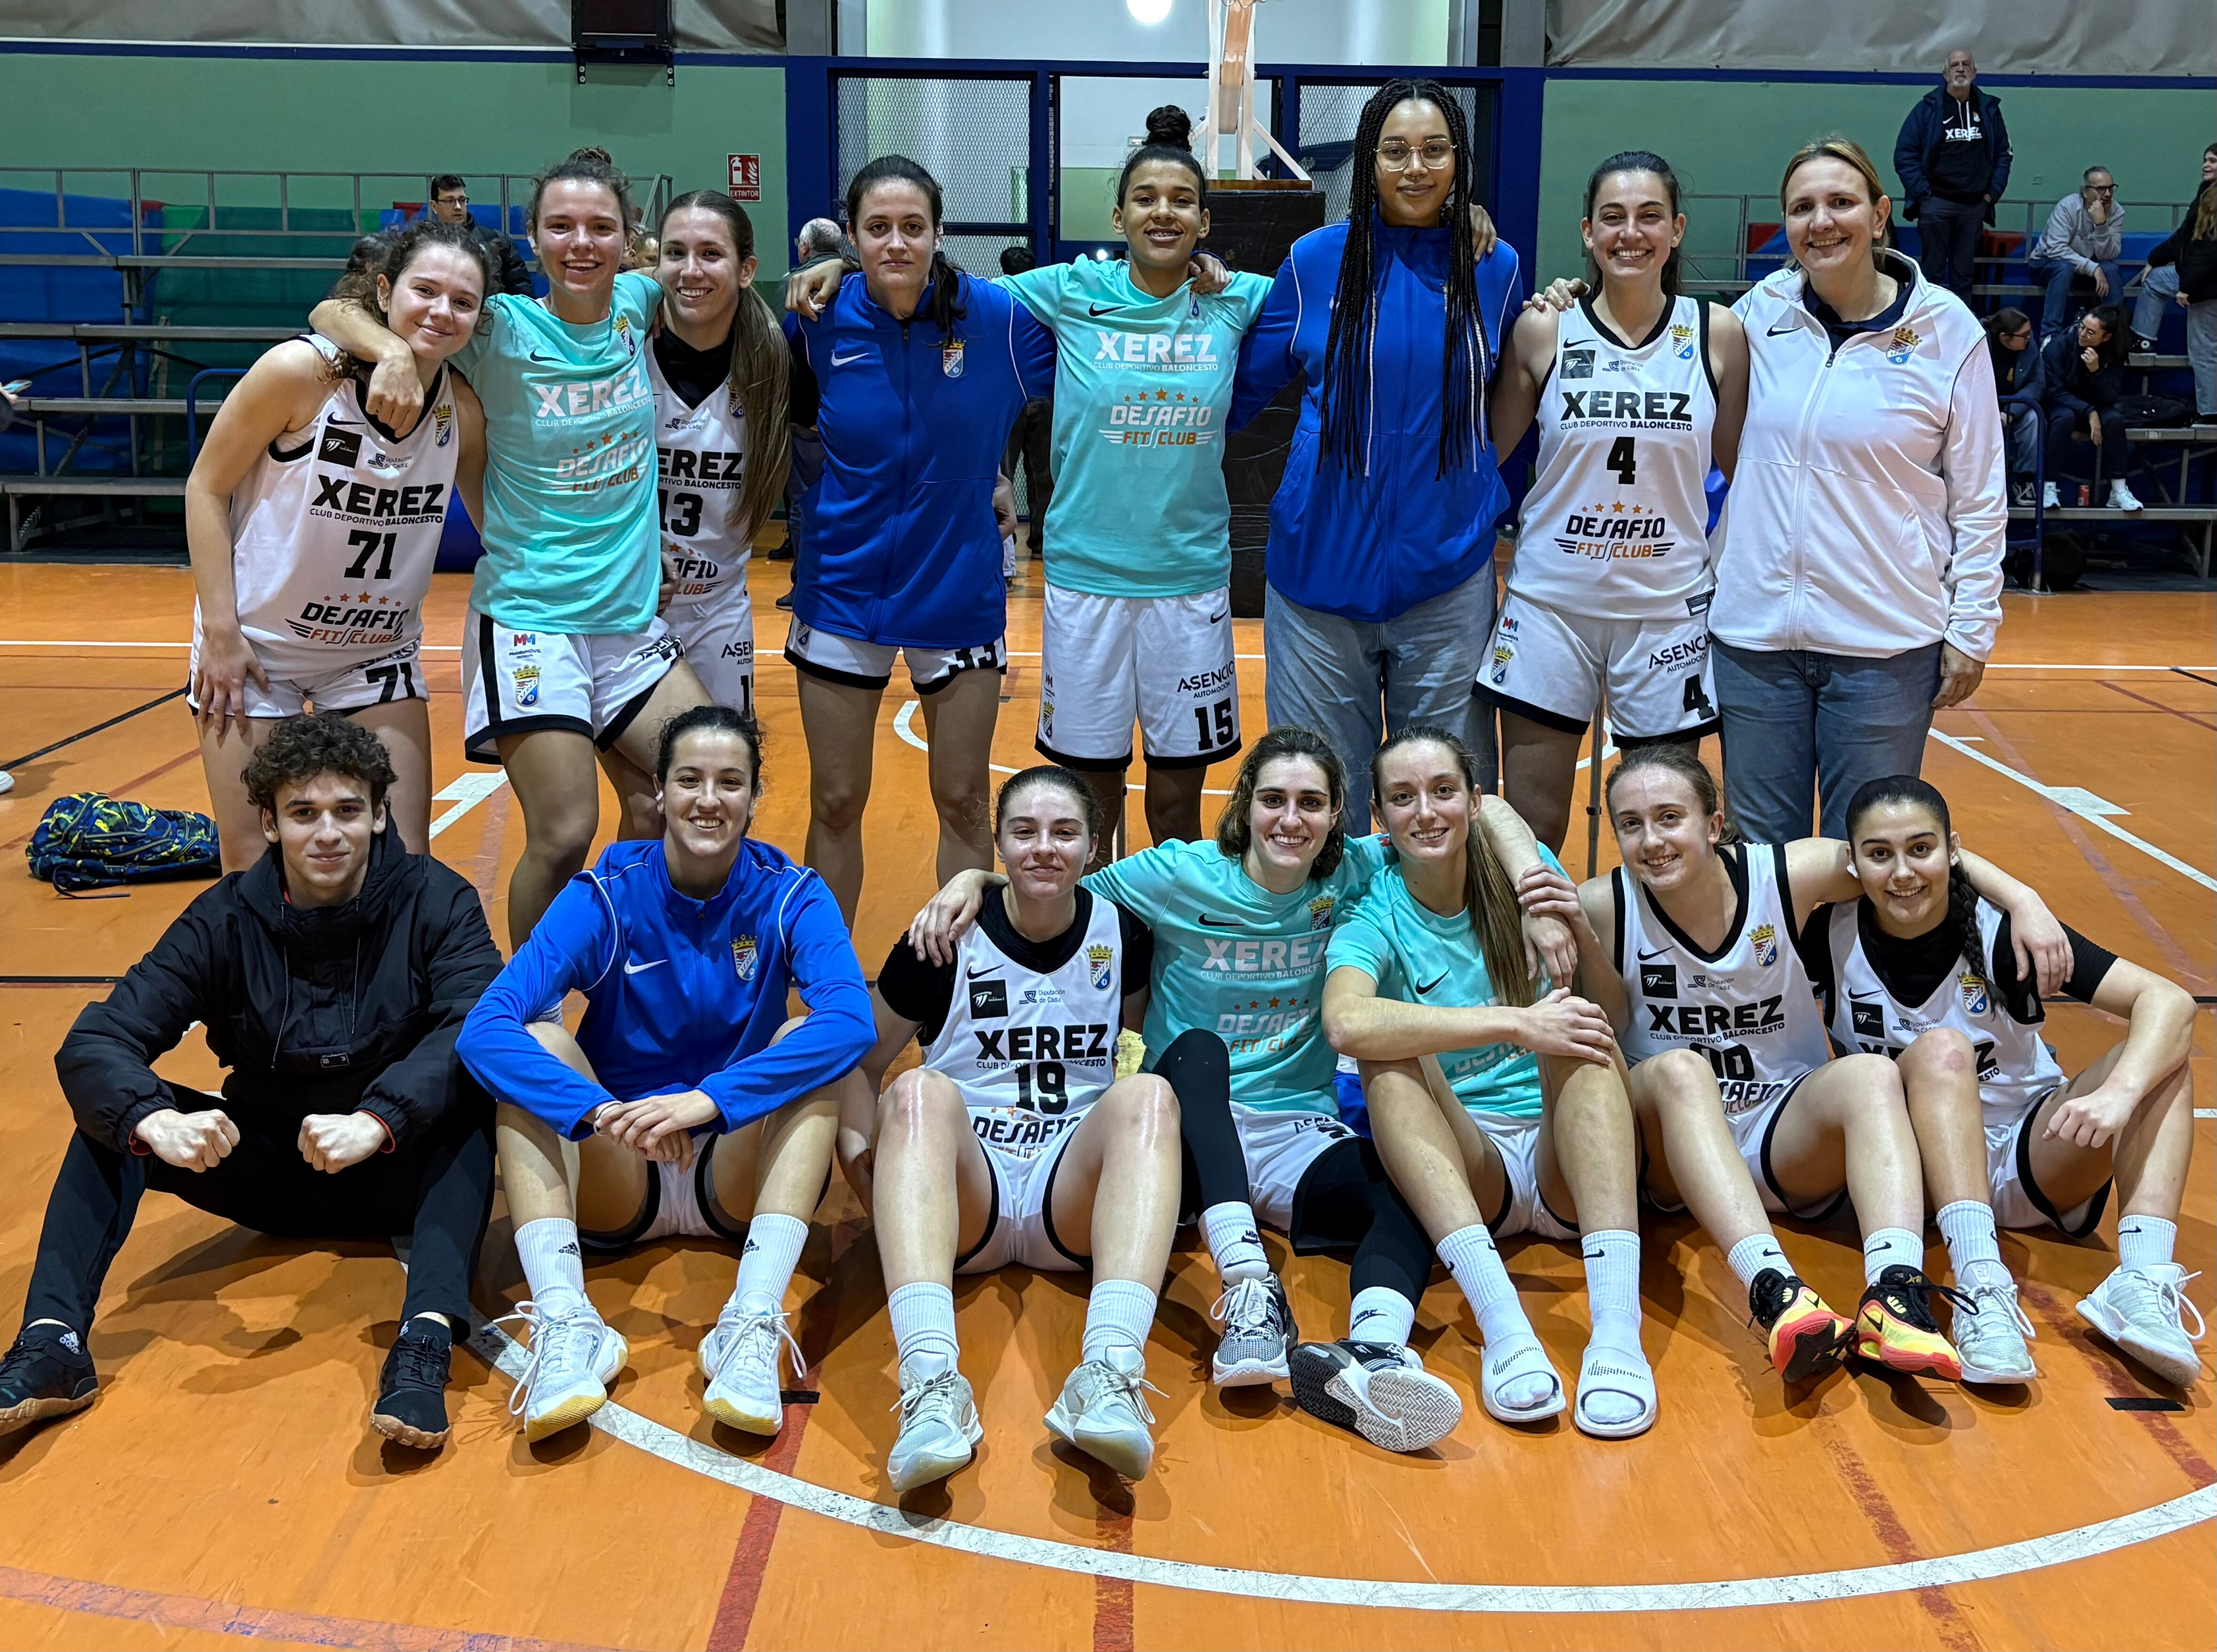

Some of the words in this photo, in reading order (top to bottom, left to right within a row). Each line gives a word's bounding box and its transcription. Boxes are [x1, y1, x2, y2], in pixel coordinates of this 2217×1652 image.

[1094, 331, 1217, 363] XEREZ
[1115, 363, 1160, 371] DEPORTIVO
[1161, 363, 1218, 372] BALONCESTO
[534, 366, 649, 418] XEREZ
[606, 396, 652, 418] BALONCESTO
[1561, 391, 1692, 422] XEREZ
[1110, 405, 1212, 426] DESAFIO
[1560, 422, 1578, 430] CLUB
[1630, 421, 1692, 431] BALONCESTO
[1123, 431, 1151, 444] FIT
[1158, 432, 1197, 446] CLUB
[556, 437, 649, 478] DESAFIO
[658, 447, 743, 481] EREZ
[1606, 437, 1636, 485] 4
[608, 467, 640, 487] CLUB
[659, 478, 682, 486] RTIVO
[684, 479, 741, 490] BALONCESTO
[311, 474, 444, 517] XEREZ
[310, 509, 332, 517] CLUB
[335, 513, 384, 526] DEPORTIVO
[385, 515, 443, 526] BALONCESTO
[657, 489, 704, 537] 13
[1565, 514, 1666, 539] DESAFIO
[344, 529, 397, 579] 71
[1576, 542, 1604, 556] FIT
[1612, 544, 1653, 558] CLUB
[674, 583, 705, 595] LUB
[310, 628, 343, 642] FIT
[350, 633, 393, 644] CLUB
[365, 662, 416, 703] 71
[1177, 660, 1234, 693] ASENCIO
[1683, 673, 1716, 720] 4
[1194, 697, 1234, 752] 15
[1202, 933, 1329, 971] XEREZ
[1200, 971, 1222, 979] CLUB
[1645, 994, 1785, 1035] XEREZ
[974, 1024, 1108, 1061] XEREZ
[1722, 1022, 1785, 1041] BALONCESTO
[1015, 1061, 1068, 1115] 19
